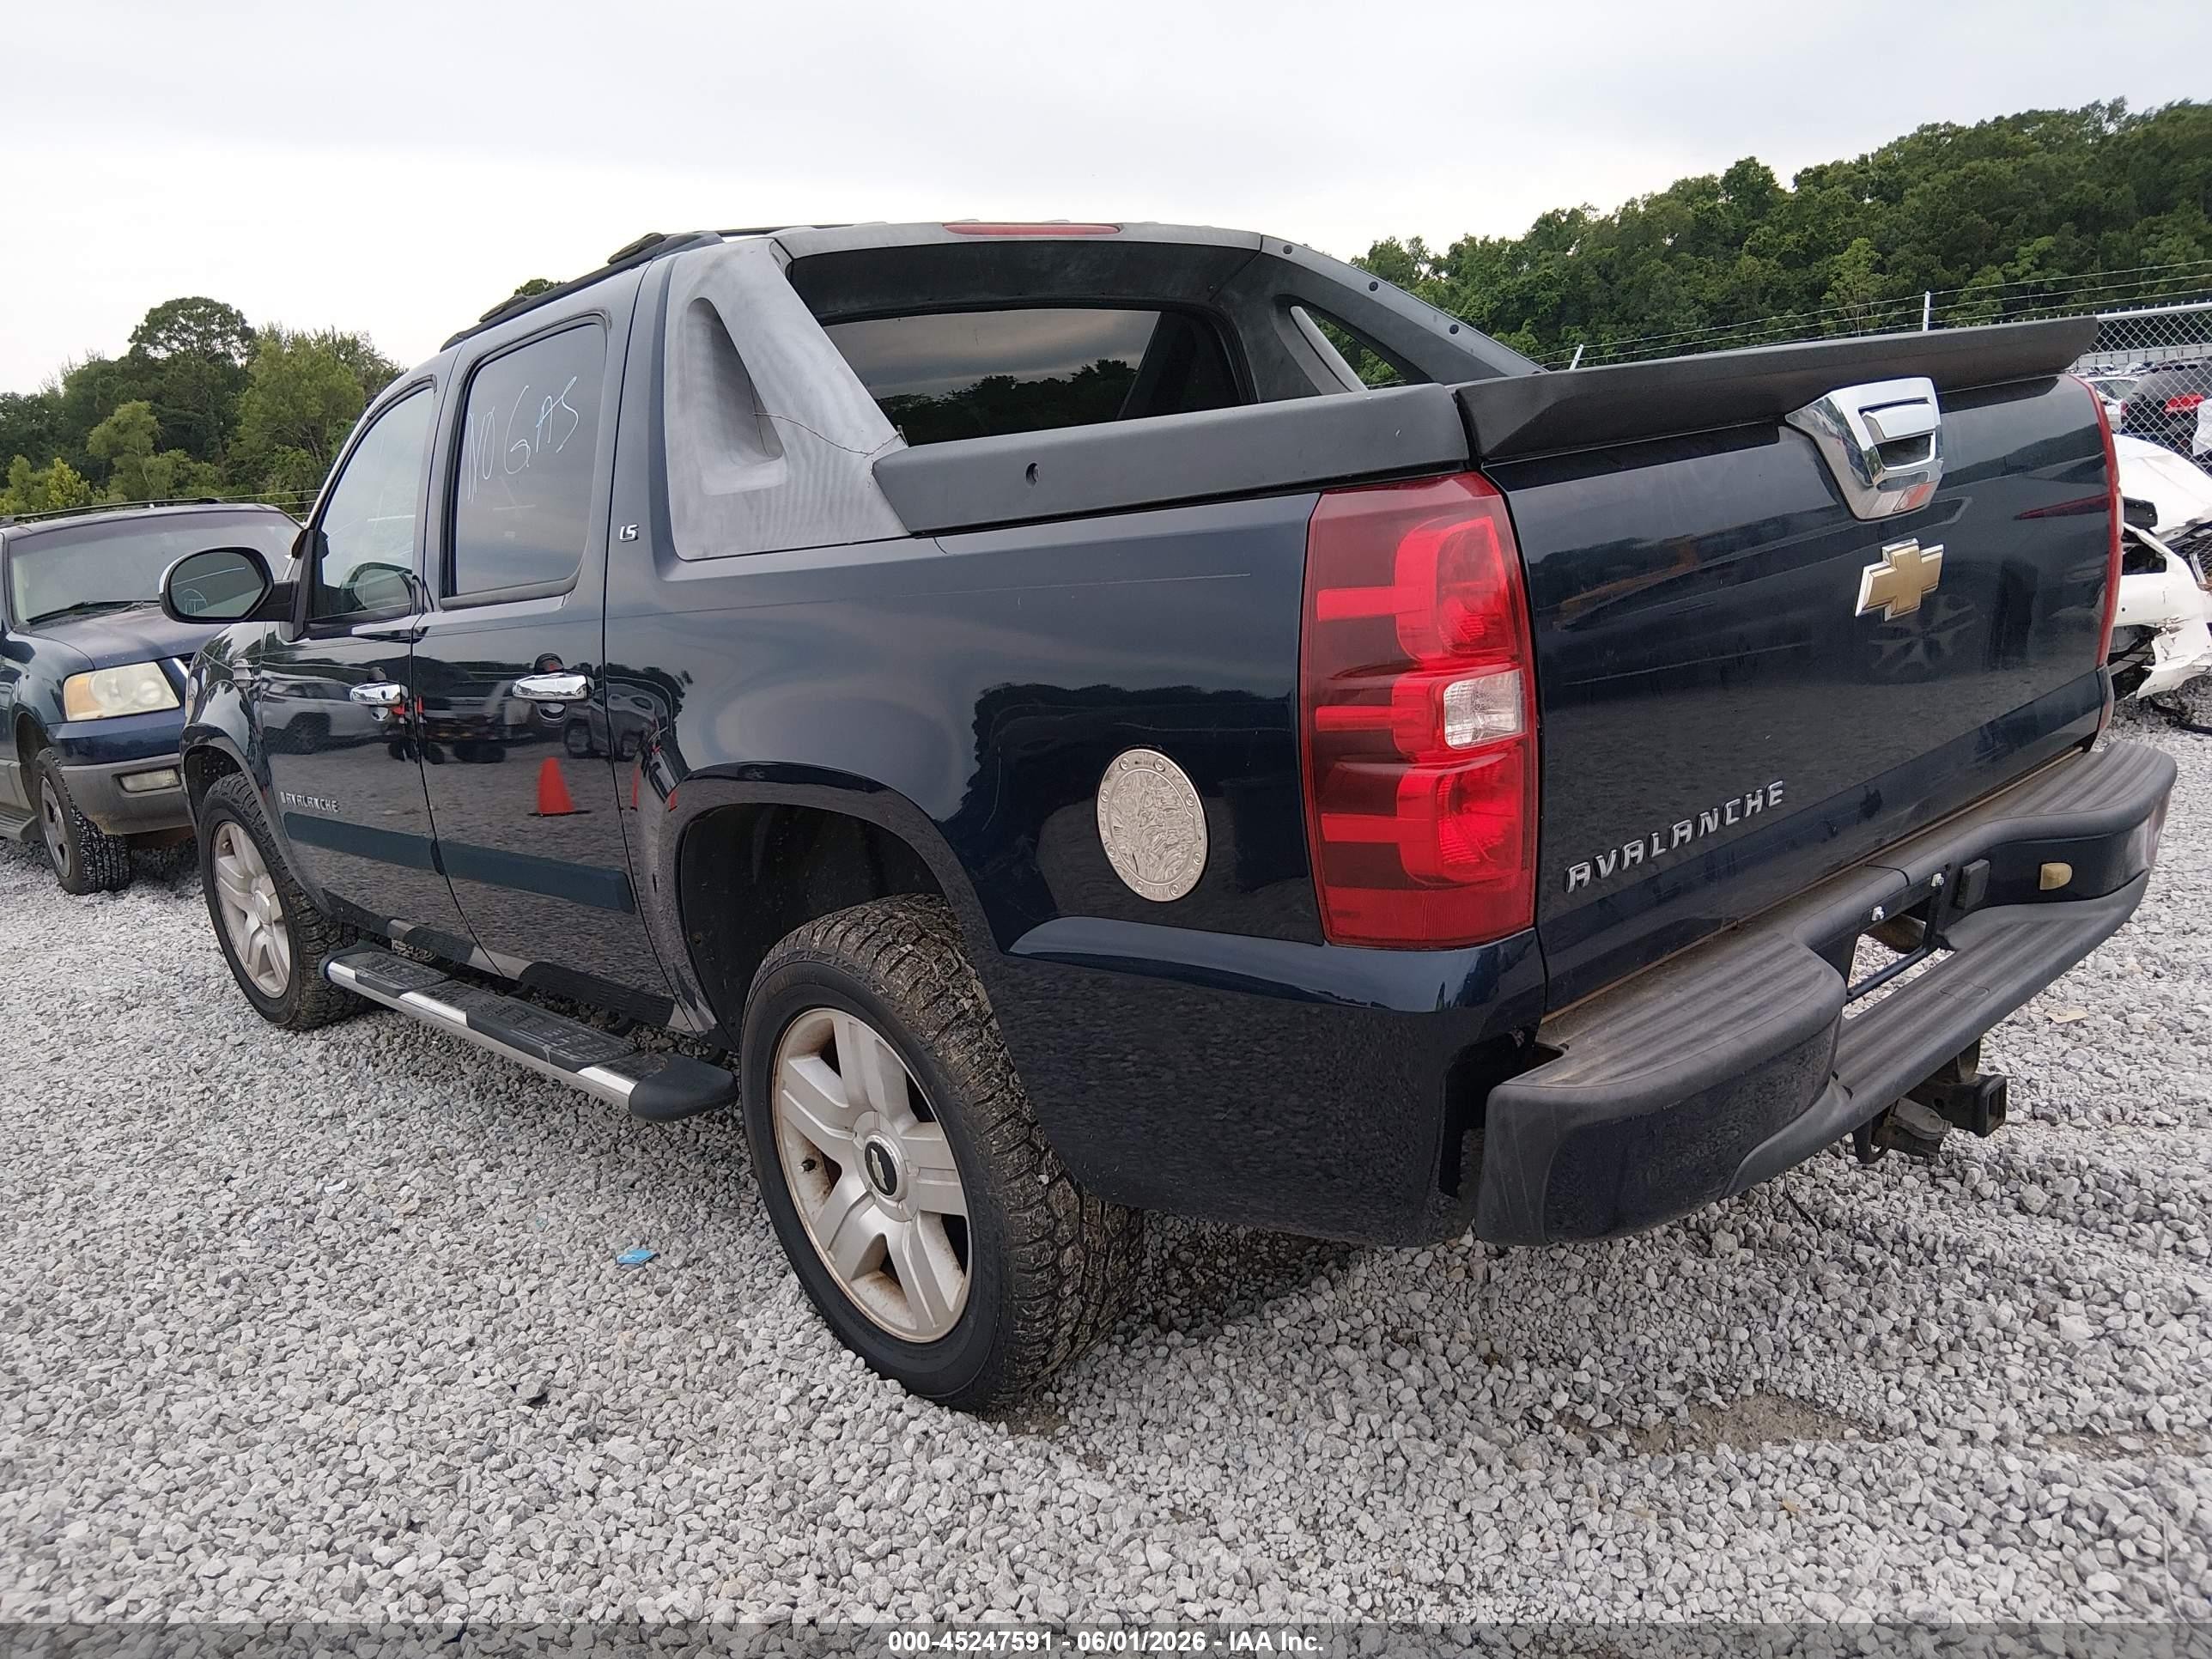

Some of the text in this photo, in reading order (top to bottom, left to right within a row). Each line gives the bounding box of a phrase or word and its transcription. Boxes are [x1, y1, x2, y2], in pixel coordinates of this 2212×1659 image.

[466, 376, 580, 503] NO GAS
[619, 524, 638, 542] LS
[284, 792, 339, 813] AVALANCHE
[1565, 780, 1784, 893] AVALANCHE
